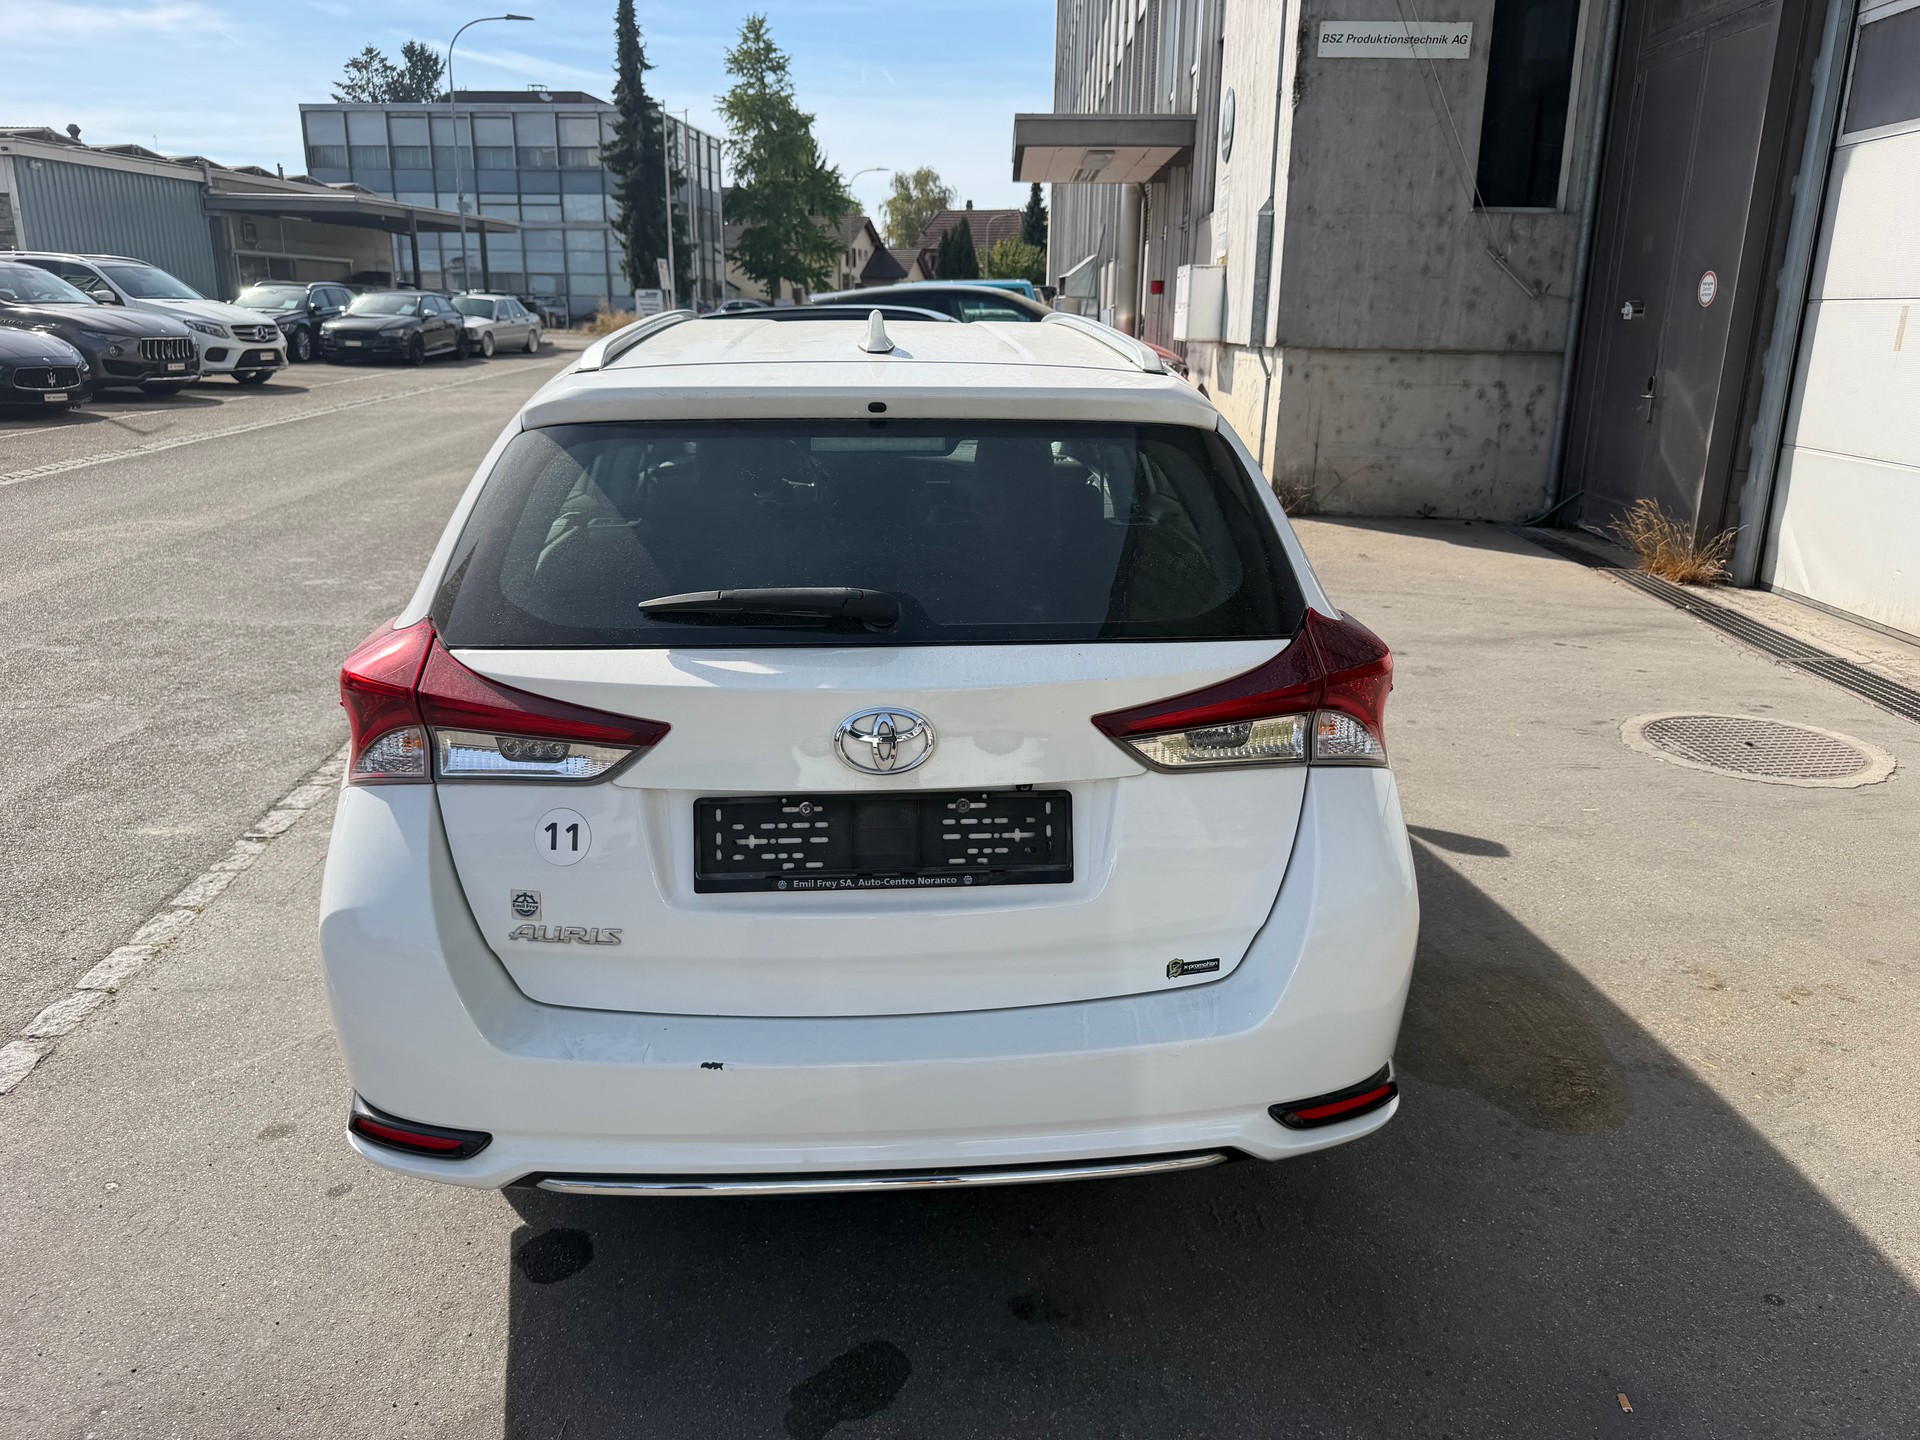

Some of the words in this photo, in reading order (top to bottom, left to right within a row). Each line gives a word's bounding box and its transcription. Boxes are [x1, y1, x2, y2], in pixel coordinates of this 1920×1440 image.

[1322, 33, 1344, 44] BSZ
[1346, 34, 1448, 45] Produktionstechnik
[1451, 35, 1468, 45] AG
[544, 822, 579, 852] 11
[793, 879, 815, 888] Emil
[817, 879, 837, 889] Frey
[840, 879, 855, 888] SA,
[858, 877, 915, 887] Auto-Centro
[918, 876, 957, 886] Noranco
[508, 924, 622, 946] AURIS
